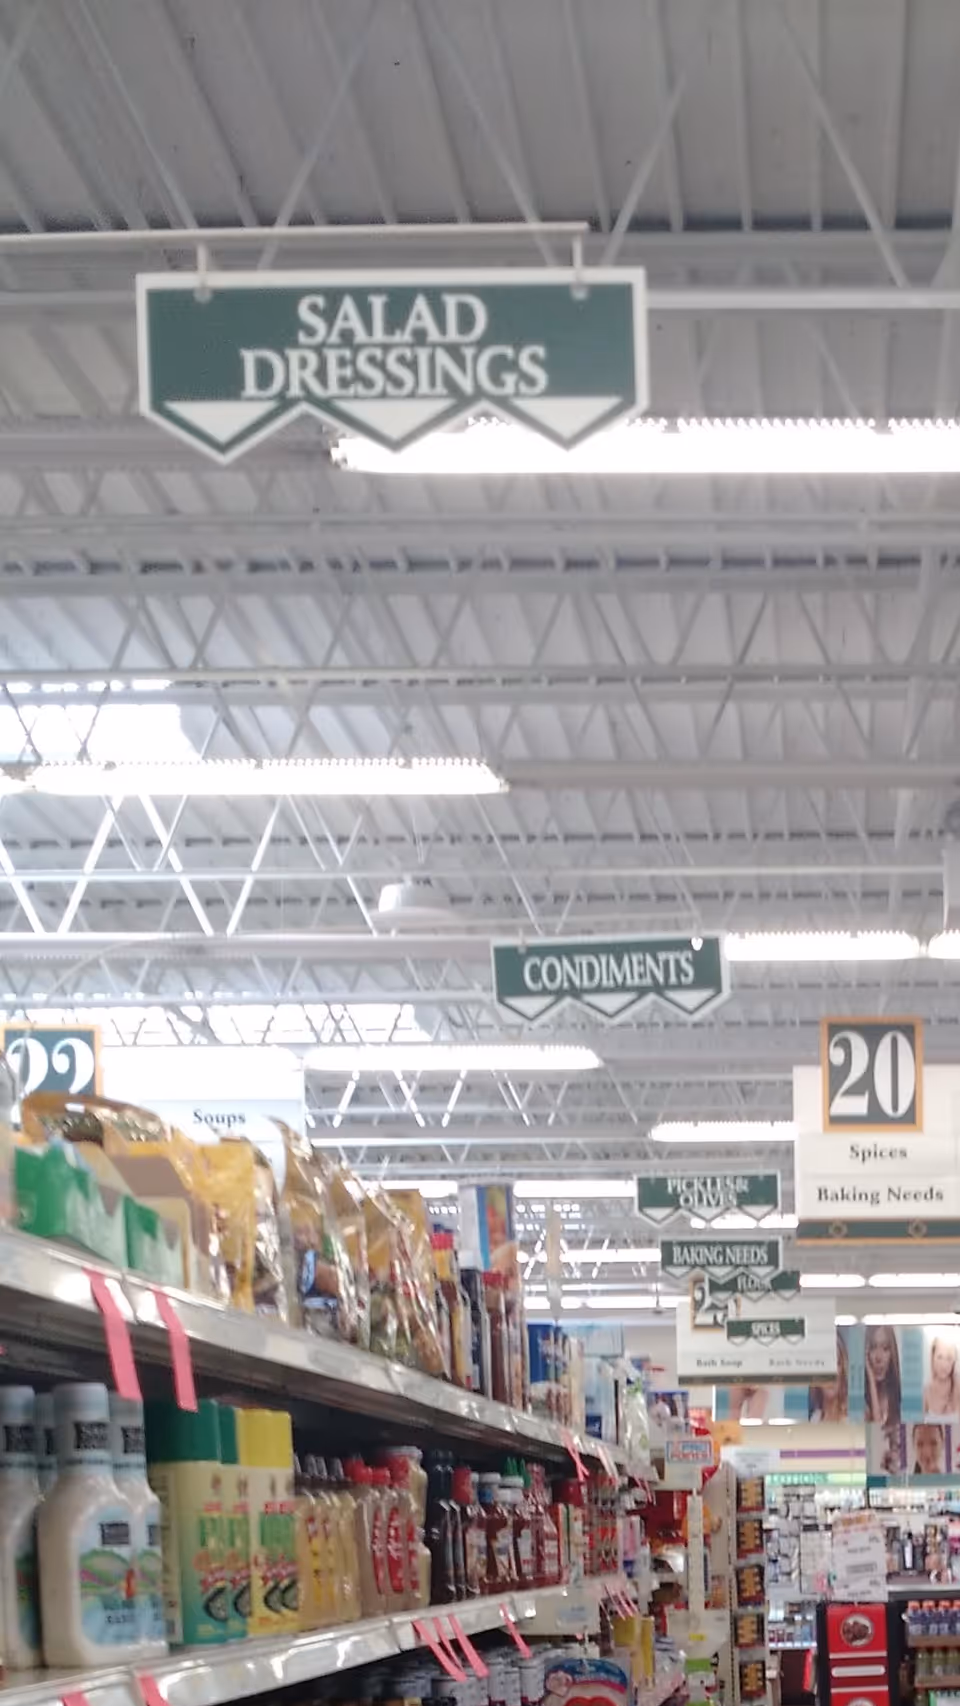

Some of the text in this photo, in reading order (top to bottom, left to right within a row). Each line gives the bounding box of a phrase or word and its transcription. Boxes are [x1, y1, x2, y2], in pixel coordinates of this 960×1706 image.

[296, 294, 488, 345] SALAD
[241, 346, 548, 400] DRESSINGS
[523, 951, 695, 991] CONDIMENTS
[829, 1030, 916, 1118] 20
[193, 1108, 246, 1128] Soups
[849, 1144, 908, 1164] Spices
[817, 1186, 944, 1206] Baking Needs
[673, 1243, 768, 1265] BAKING NEEDS
